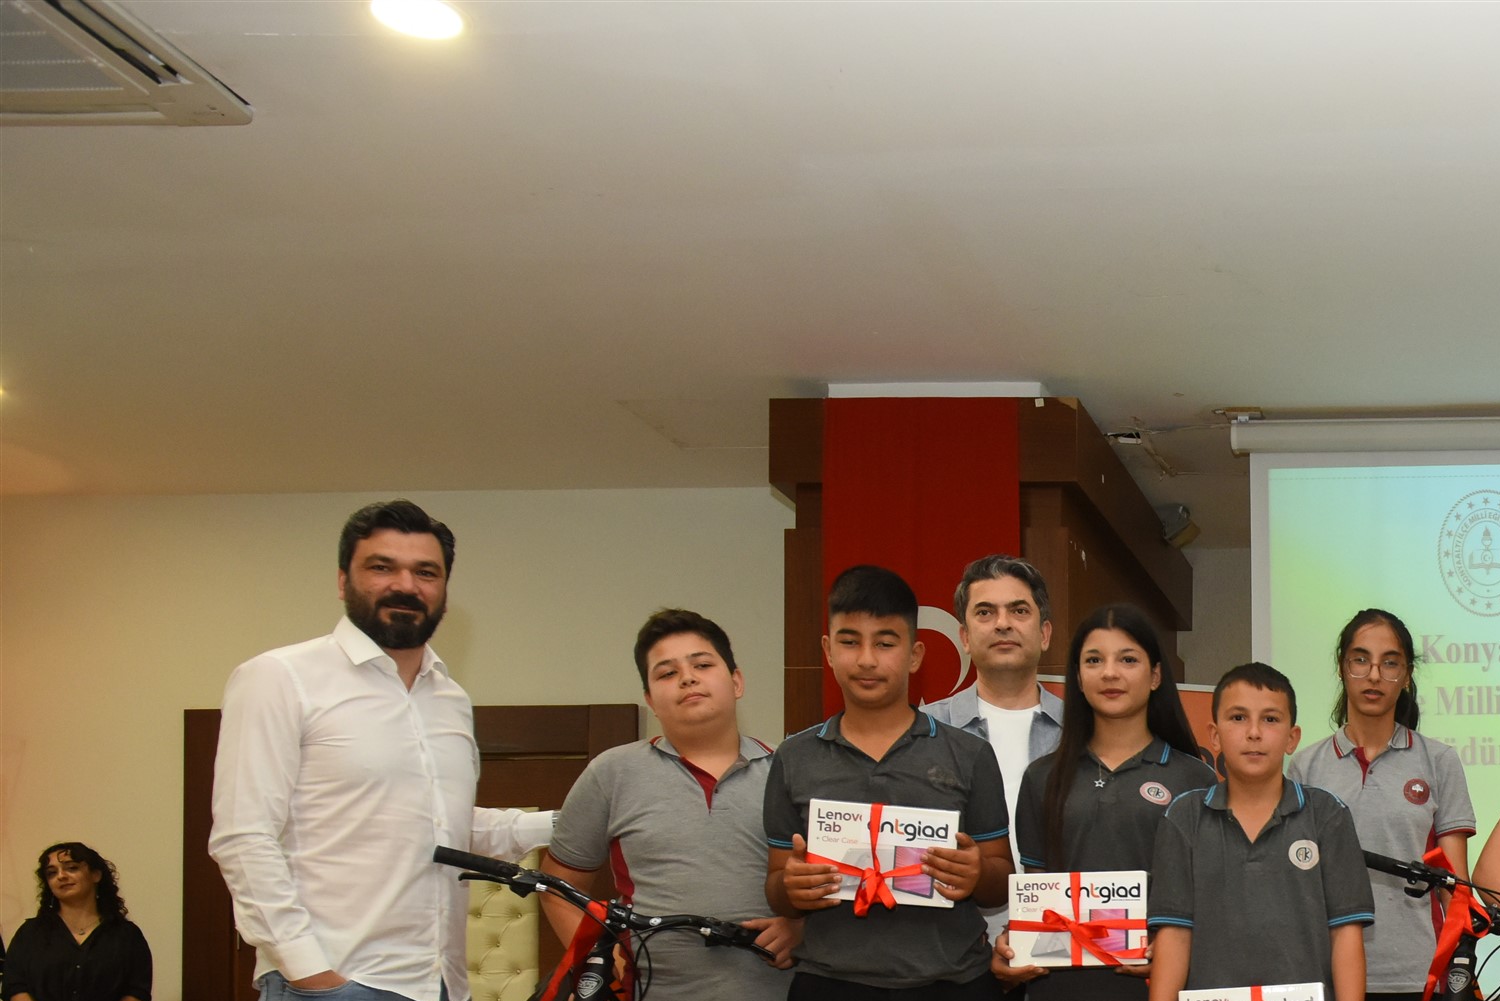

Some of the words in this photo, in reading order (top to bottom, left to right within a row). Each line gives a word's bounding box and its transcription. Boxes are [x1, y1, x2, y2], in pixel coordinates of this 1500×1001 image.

[817, 821, 842, 833] Tab
[867, 818, 949, 842] ntgiad
[822, 836, 840, 844] Clear
[841, 837, 859, 845] Case
[1016, 893, 1039, 903] Tab
